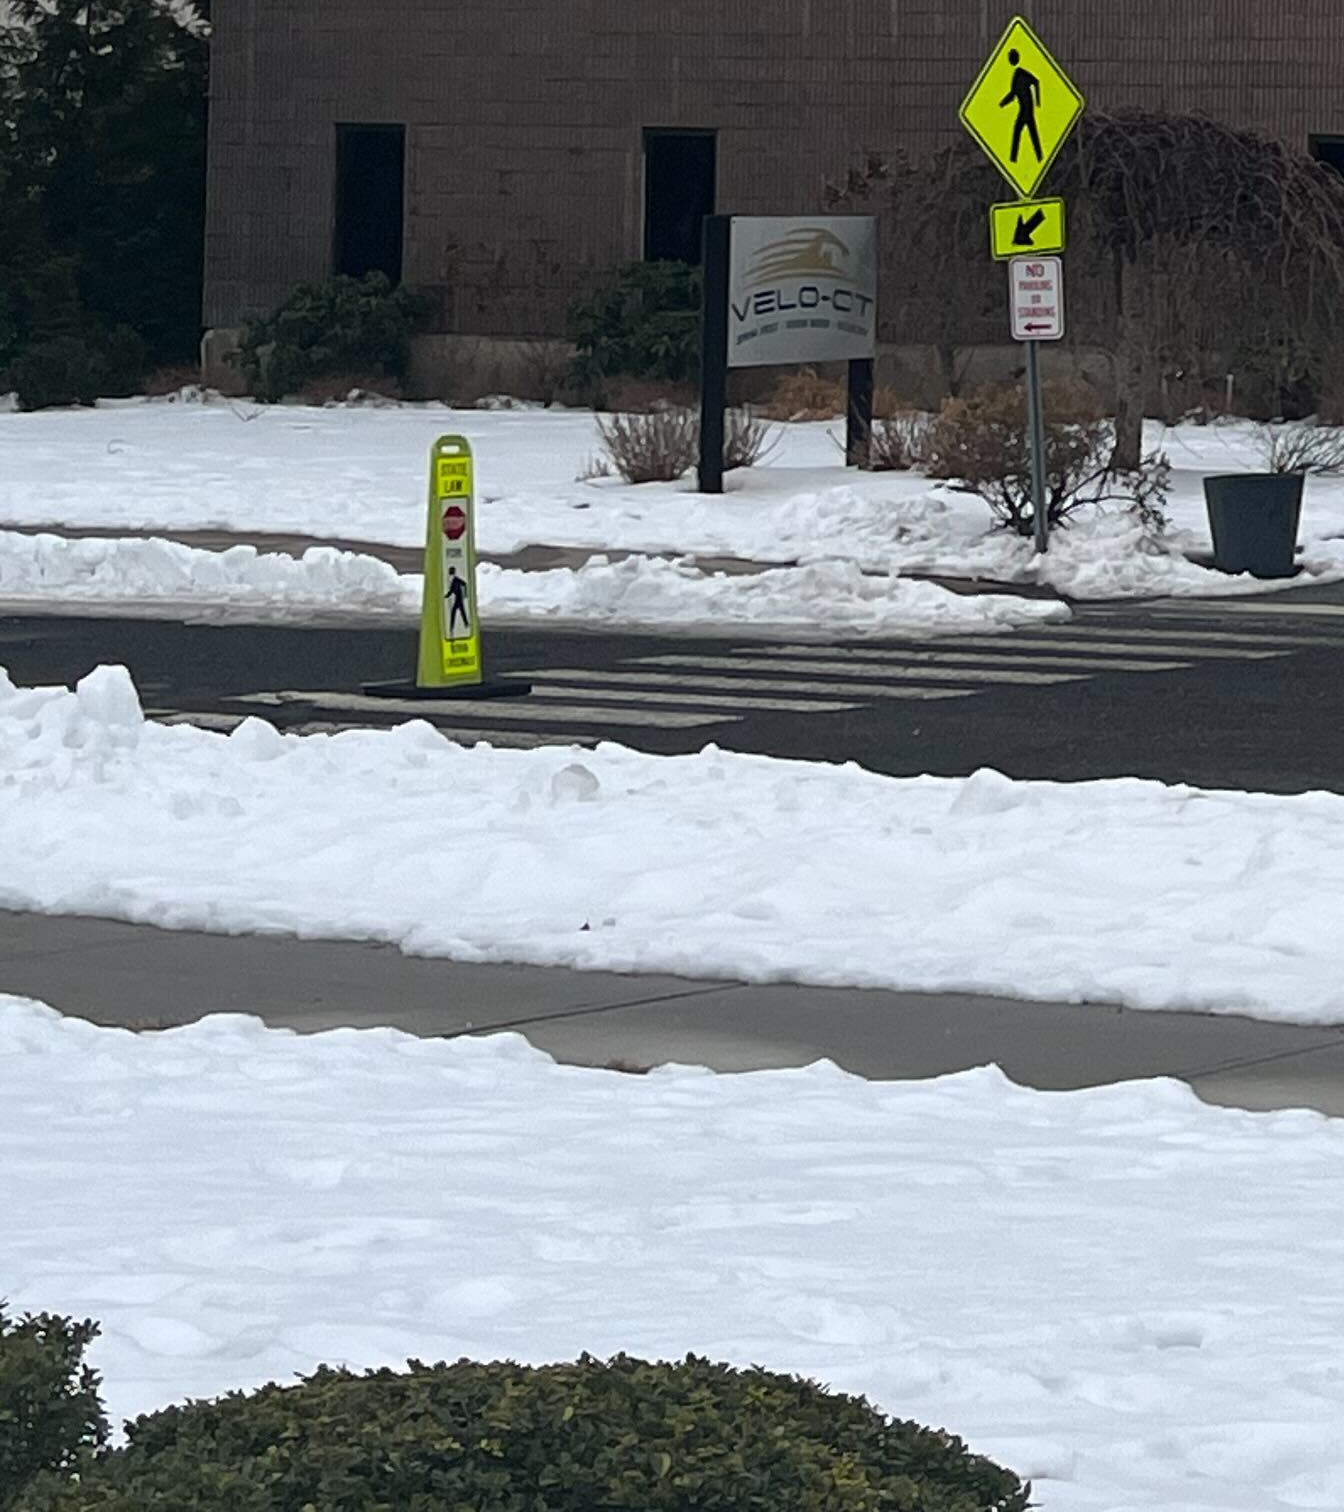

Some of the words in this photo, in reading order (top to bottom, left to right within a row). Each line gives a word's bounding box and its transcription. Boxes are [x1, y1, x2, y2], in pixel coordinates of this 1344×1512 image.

[1025, 264, 1045, 277] NO
[732, 286, 873, 322] VELO-CT
[444, 479, 463, 493] LAW
